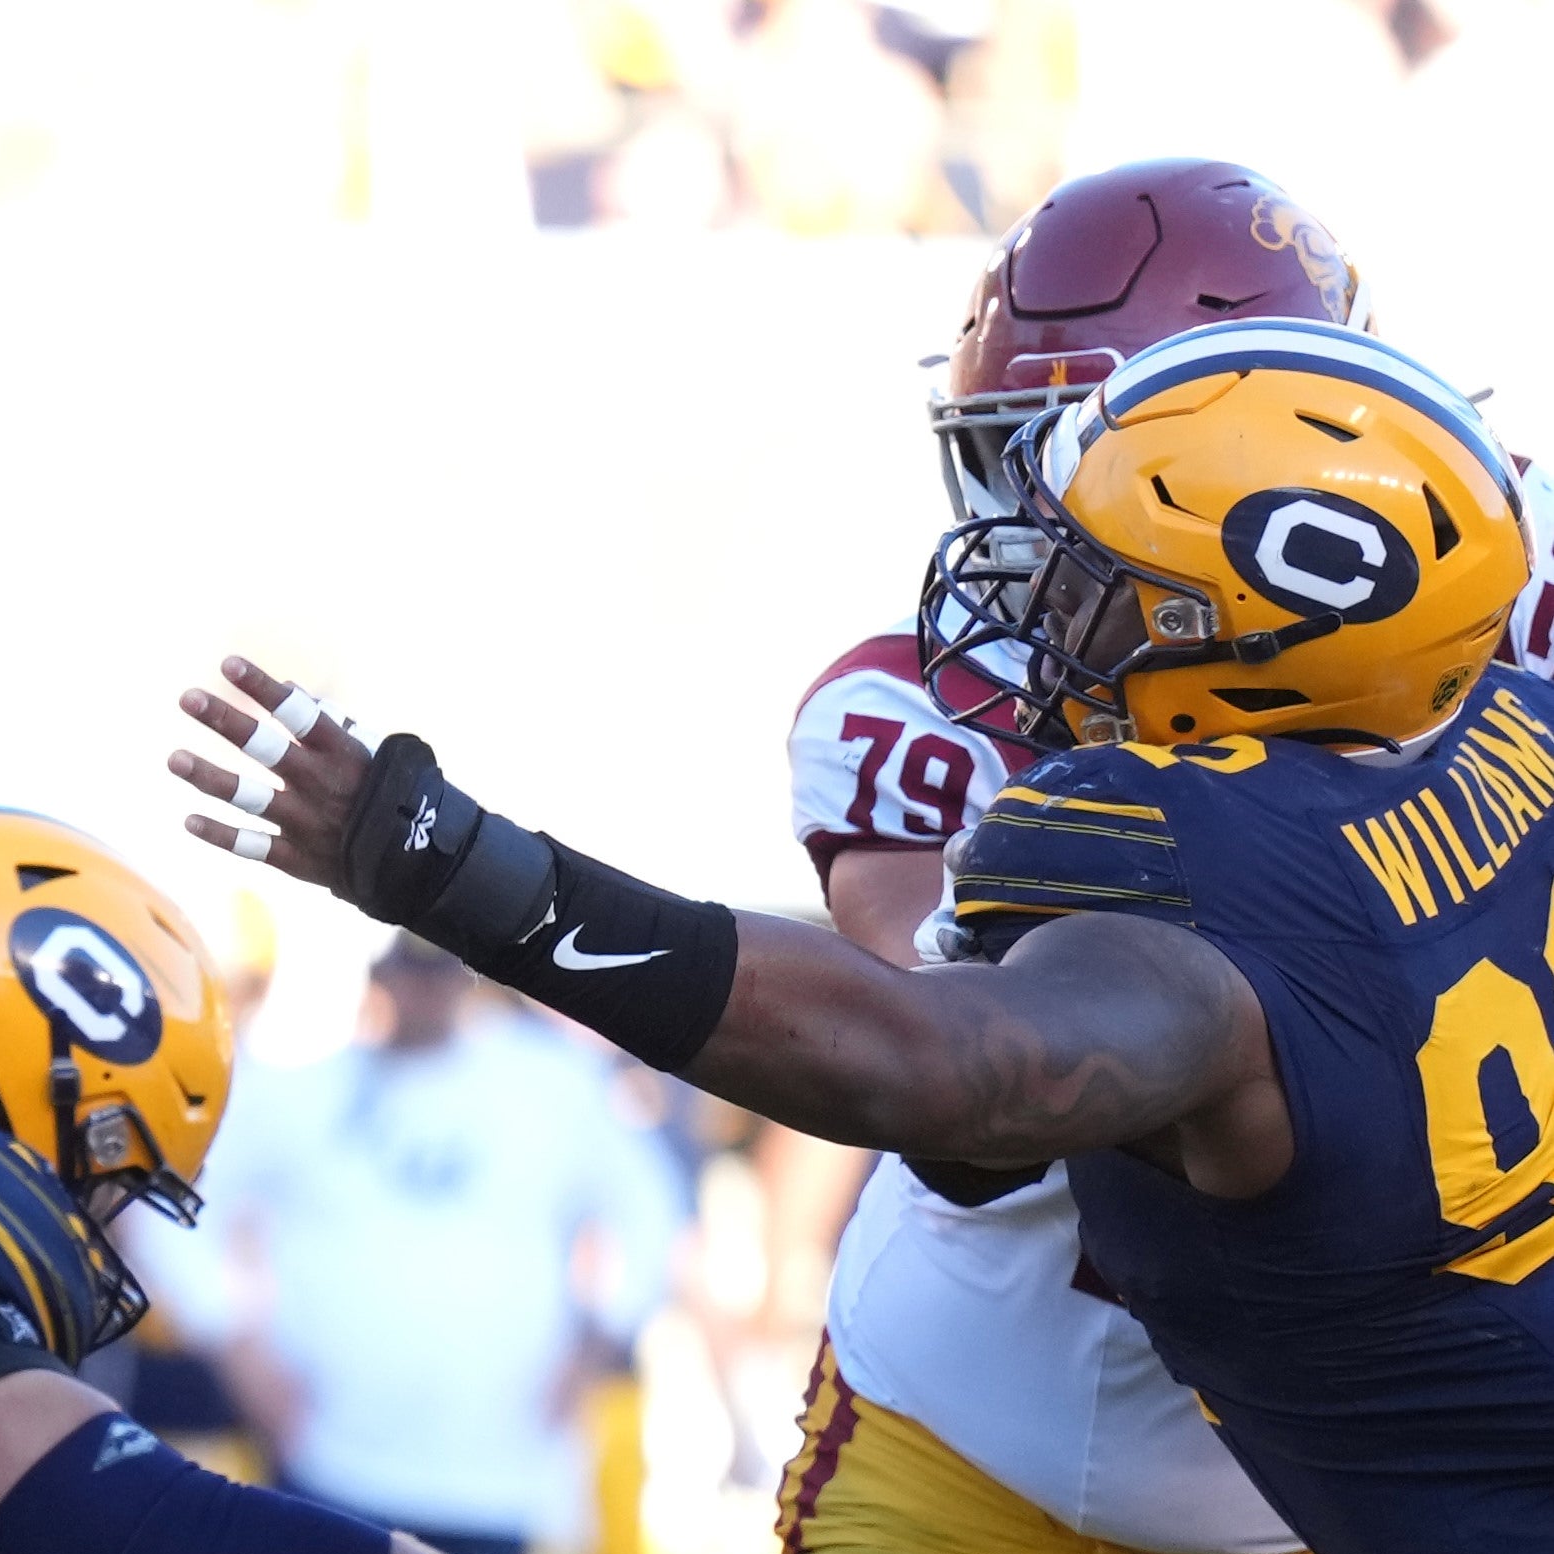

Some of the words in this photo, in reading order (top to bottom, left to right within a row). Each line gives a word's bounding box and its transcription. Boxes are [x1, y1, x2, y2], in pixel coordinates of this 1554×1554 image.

[1254, 499, 1387, 610] C
[840, 712, 975, 836] 79
[32, 925, 144, 1042] C
[1415, 940, 1554, 1286] 9
